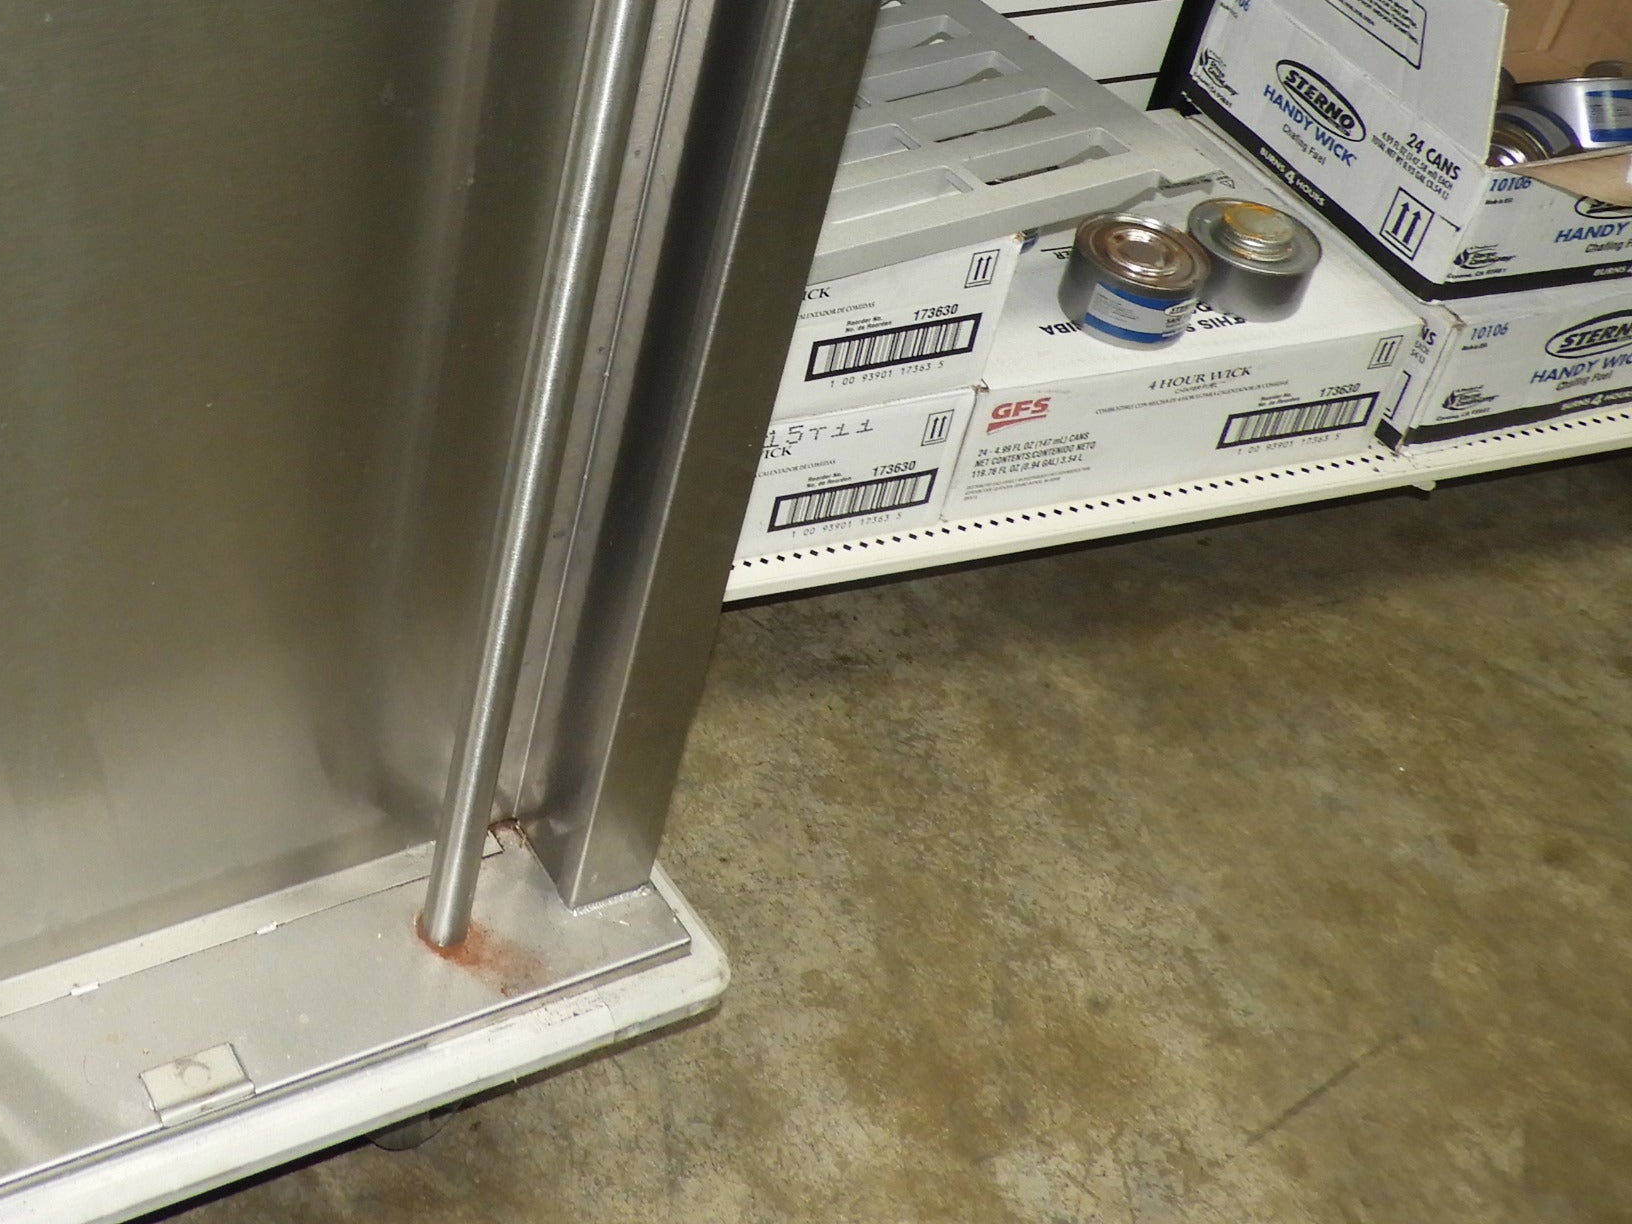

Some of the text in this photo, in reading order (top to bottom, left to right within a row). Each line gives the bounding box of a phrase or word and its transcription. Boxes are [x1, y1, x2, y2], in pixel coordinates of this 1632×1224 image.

[1285, 69, 1355, 130] STERNO
[1263, 84, 1313, 131] HANDY
[1315, 126, 1356, 167] WICK
[1406, 132, 1461, 180] 24 CANS
[1259, 147, 1326, 206] BURNS 4 HOURS
[1490, 176, 1533, 192] 10106
[1554, 222, 1630, 243] HANDY
[802, 287, 830, 300] ICK
[914, 304, 959, 321] 173630
[1421, 325, 1437, 345] NS
[1471, 322, 1509, 341] 10106
[1560, 323, 1632, 348] STERN
[862, 369, 893, 382] 93901
[901, 363, 932, 376] 17363
[1148, 379, 1157, 390] 4
[1159, 374, 1208, 389] HOUR
[1210, 366, 1251, 381] WICK
[1530, 353, 1632, 384] HANDY WIC
[1320, 383, 1361, 398] 173630
[991, 397, 1052, 420] GFS
[763, 446, 791, 459] ICK
[978, 448, 988, 457] 24
[1069, 432, 1090, 442] CANS
[991, 452, 1032, 465] CONTENTS
[1076, 441, 1096, 450] NETO
[872, 460, 917, 477] 173630
